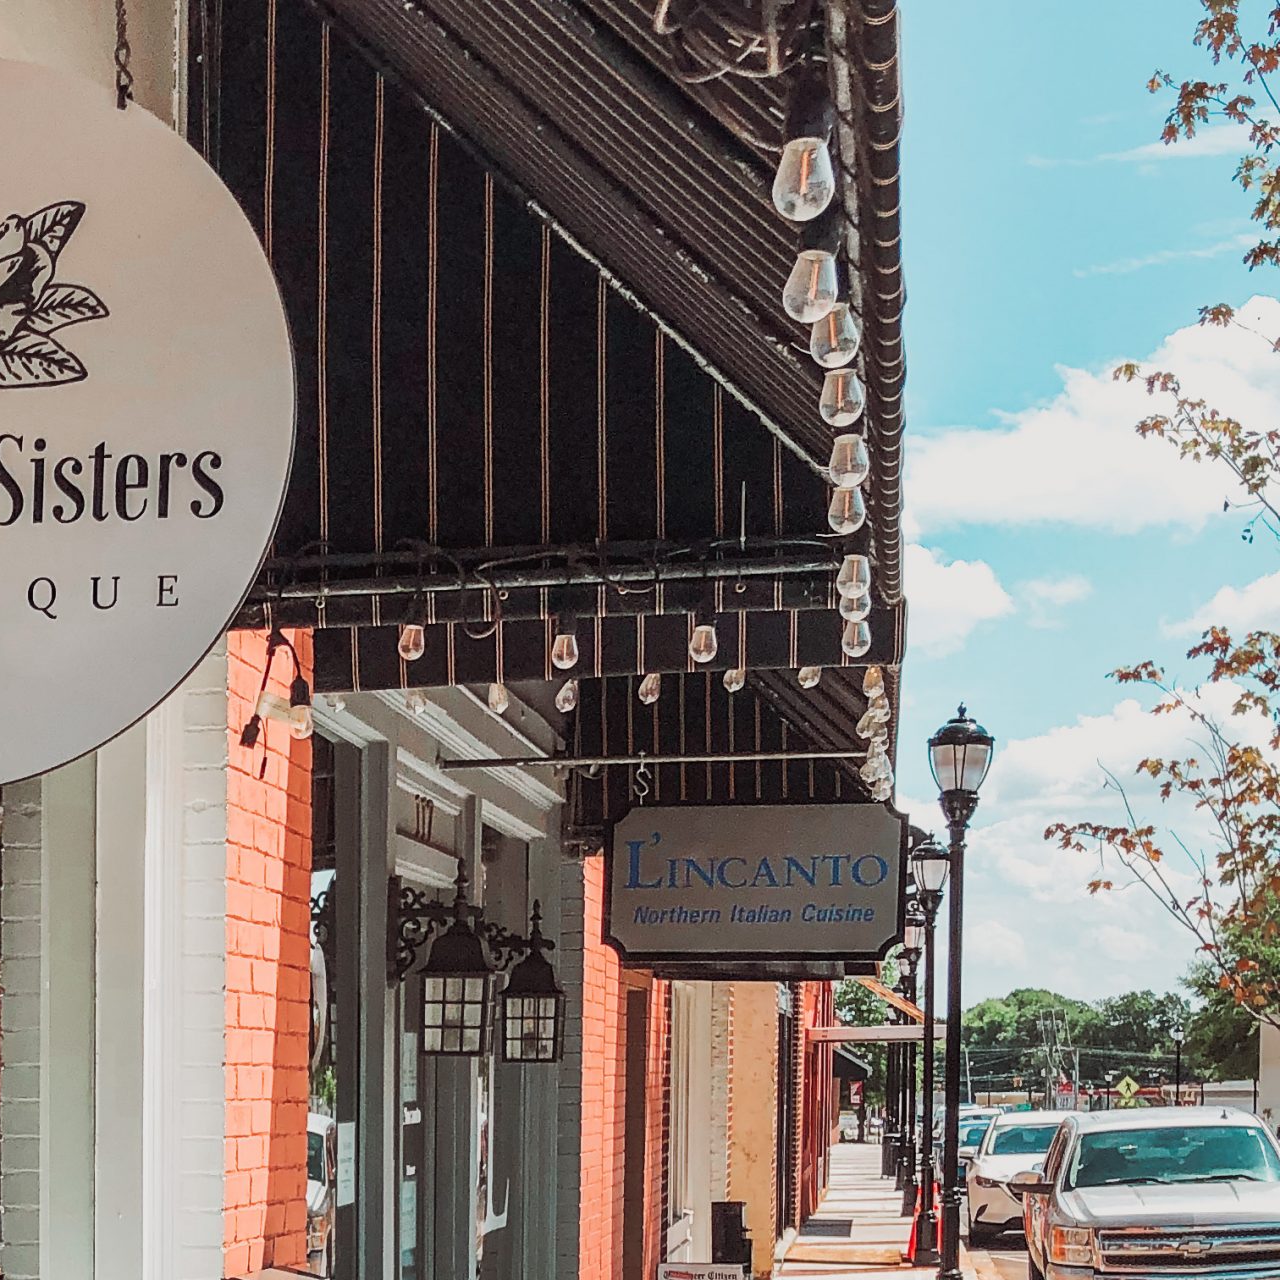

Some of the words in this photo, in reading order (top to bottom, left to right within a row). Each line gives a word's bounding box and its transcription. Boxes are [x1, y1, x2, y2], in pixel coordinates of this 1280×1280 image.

[633, 905, 721, 924] Northern
[730, 904, 791, 923] Italian
[801, 903, 875, 922] Cuisine
